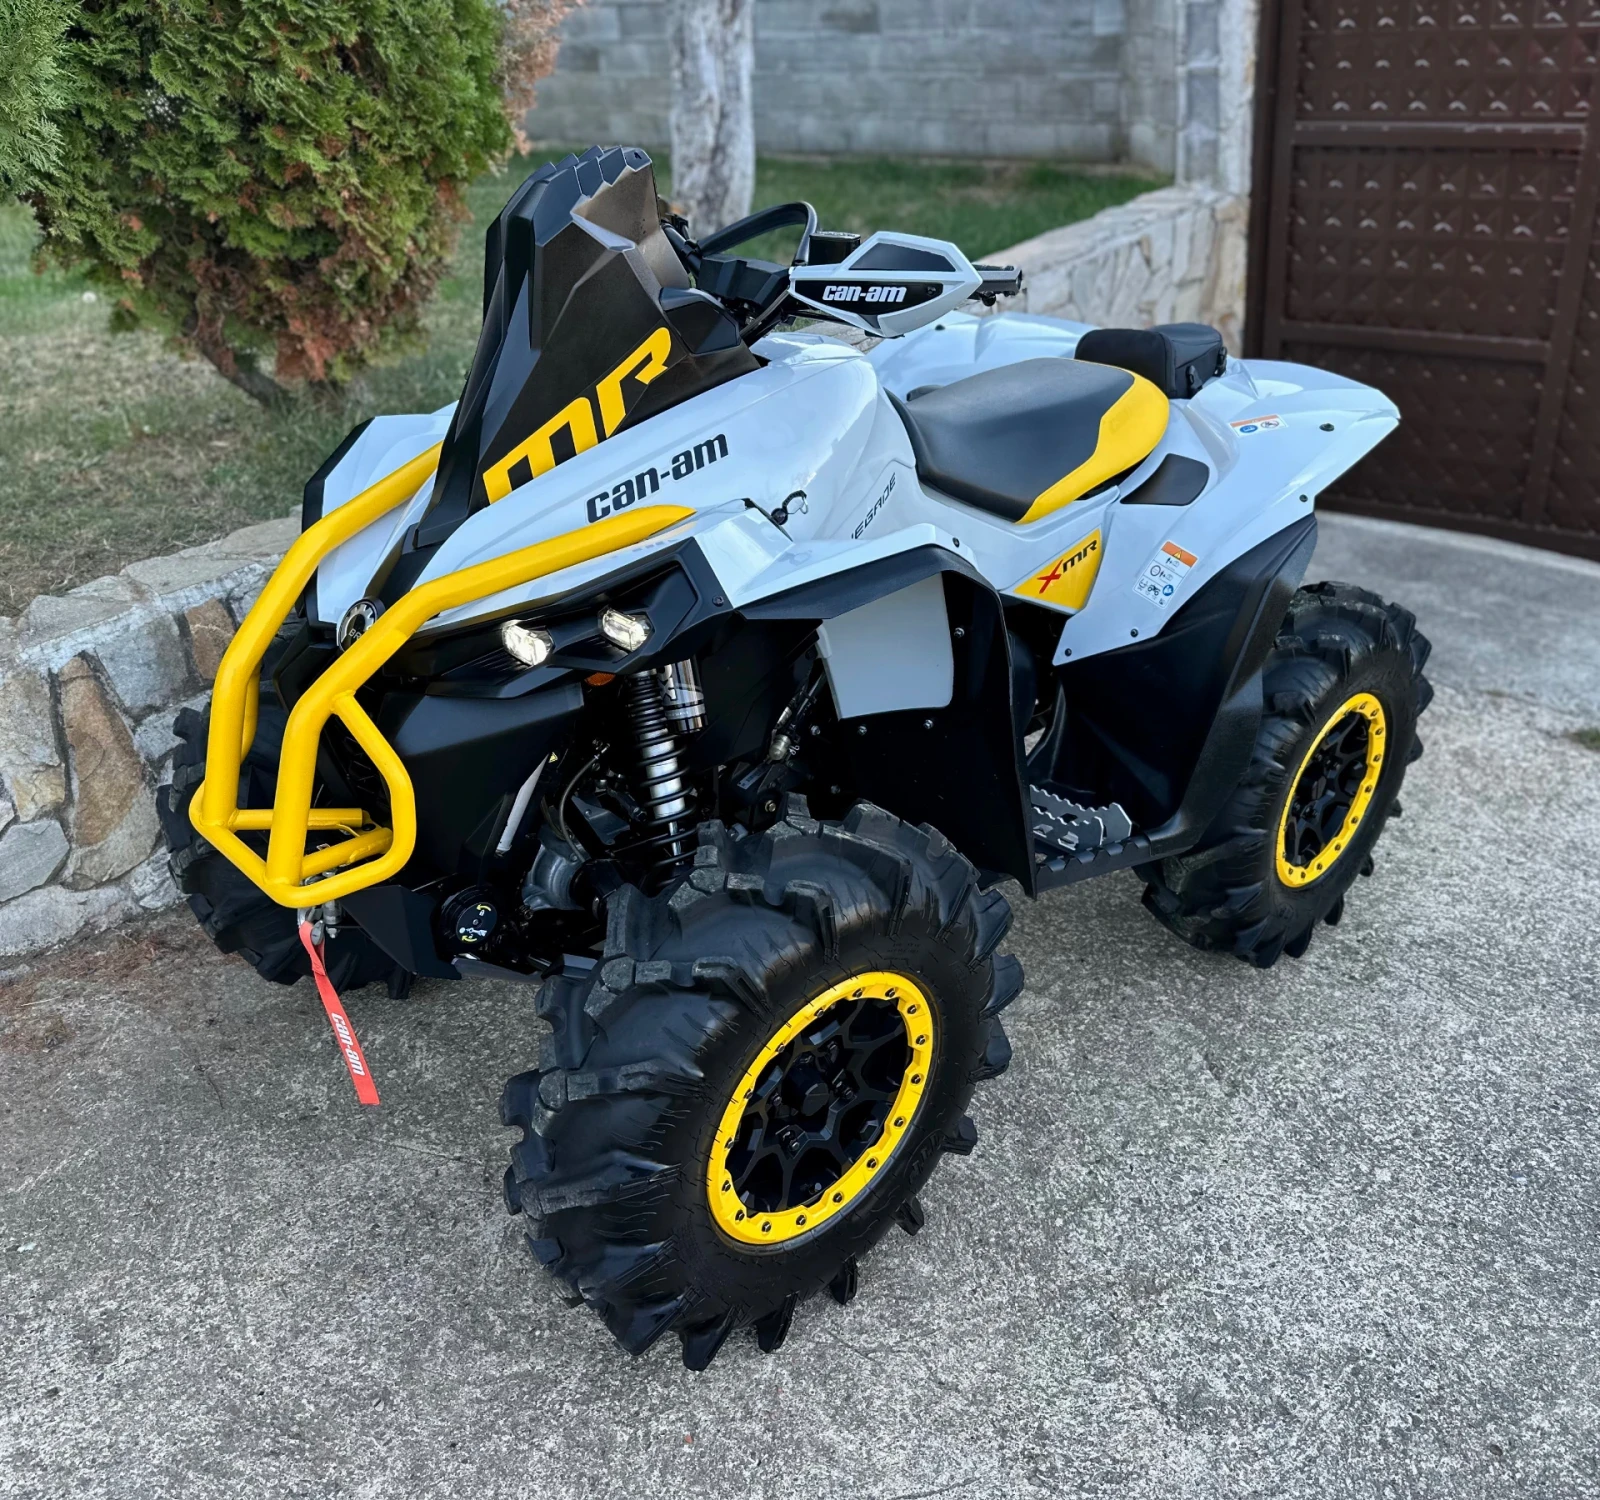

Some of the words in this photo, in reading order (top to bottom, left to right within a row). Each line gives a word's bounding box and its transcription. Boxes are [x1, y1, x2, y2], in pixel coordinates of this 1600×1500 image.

[822, 285, 907, 303] can-am
[586, 433, 729, 524] can-am
[331, 1012, 366, 1077] can-am
